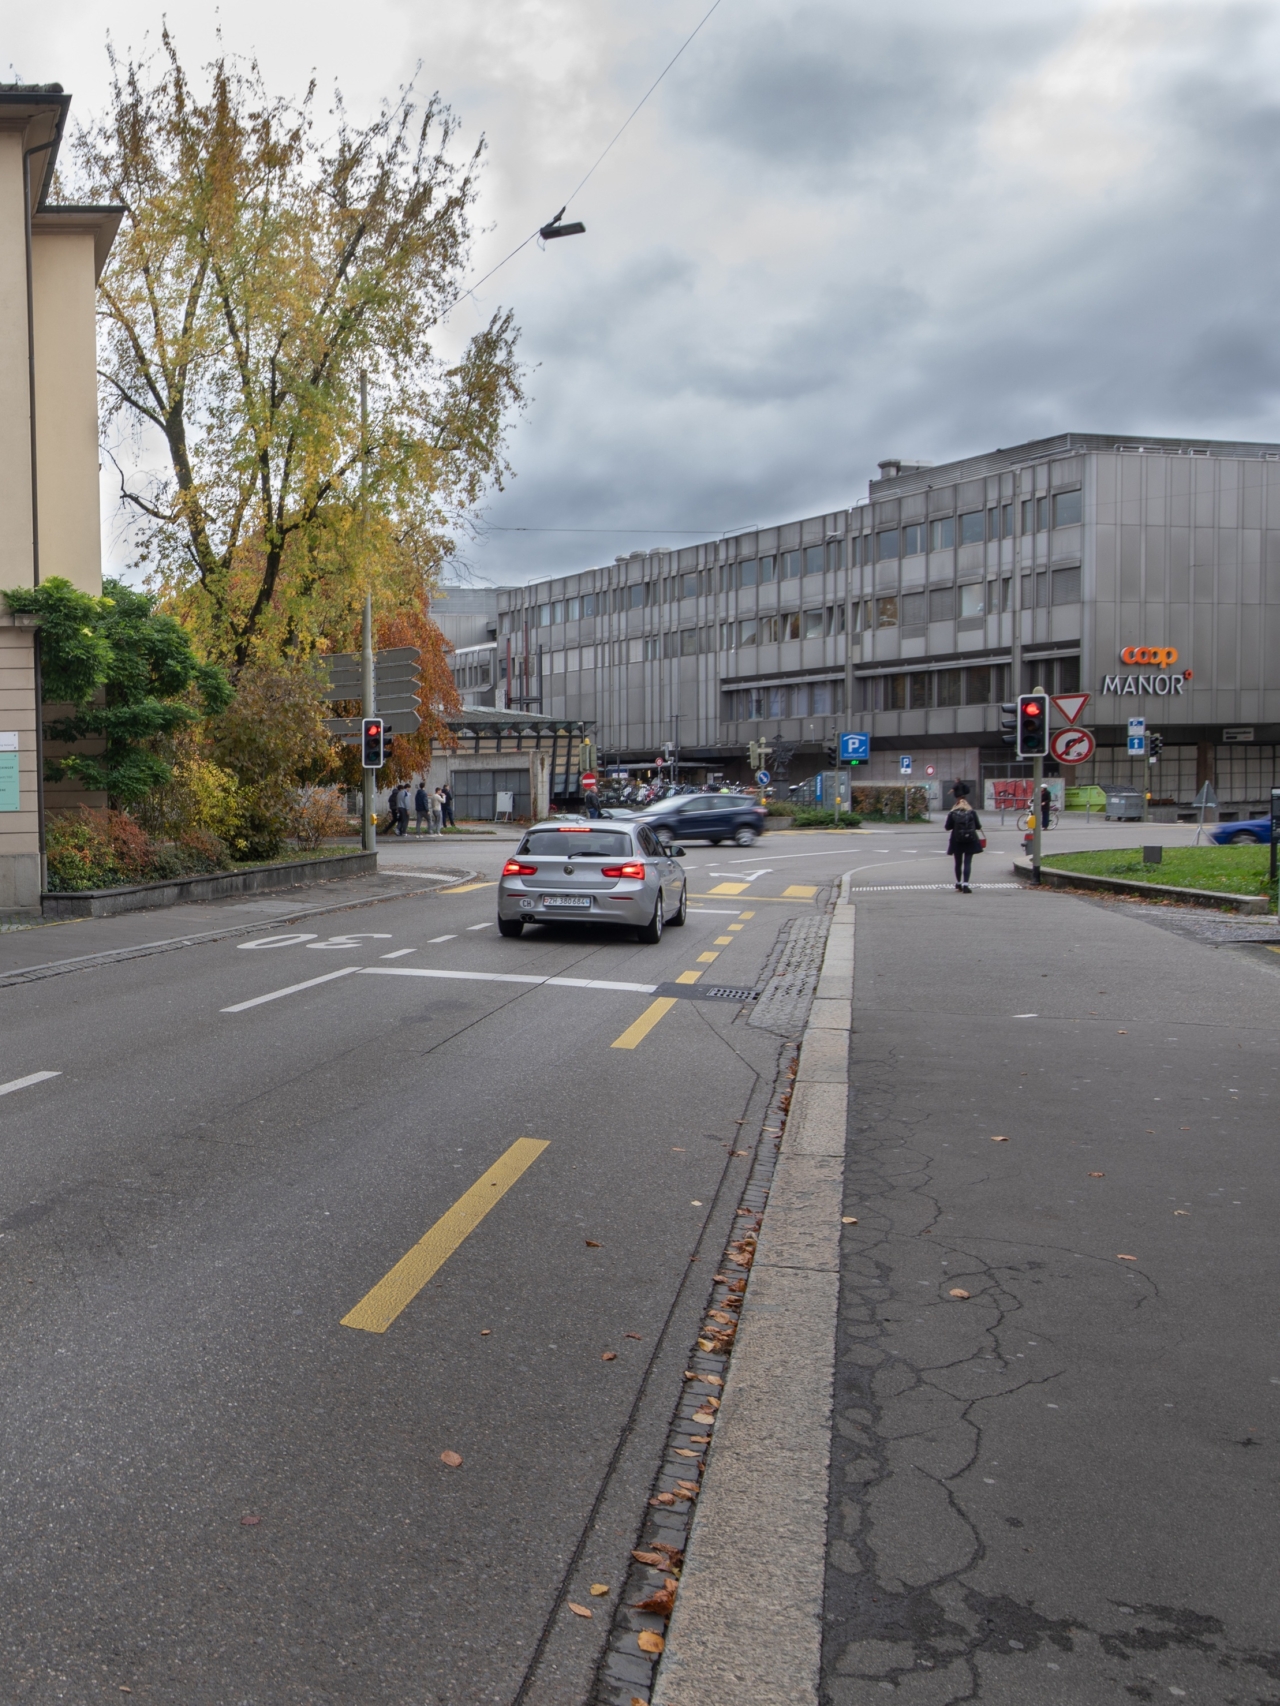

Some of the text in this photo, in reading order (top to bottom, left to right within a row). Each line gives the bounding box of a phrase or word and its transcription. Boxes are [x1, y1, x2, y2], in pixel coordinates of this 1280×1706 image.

[1121, 646, 1178, 669] coop
[1103, 674, 1185, 695] MANOR
[848, 739, 860, 752] P
[903, 758, 910, 768] P
[237, 933, 392, 949] 30
